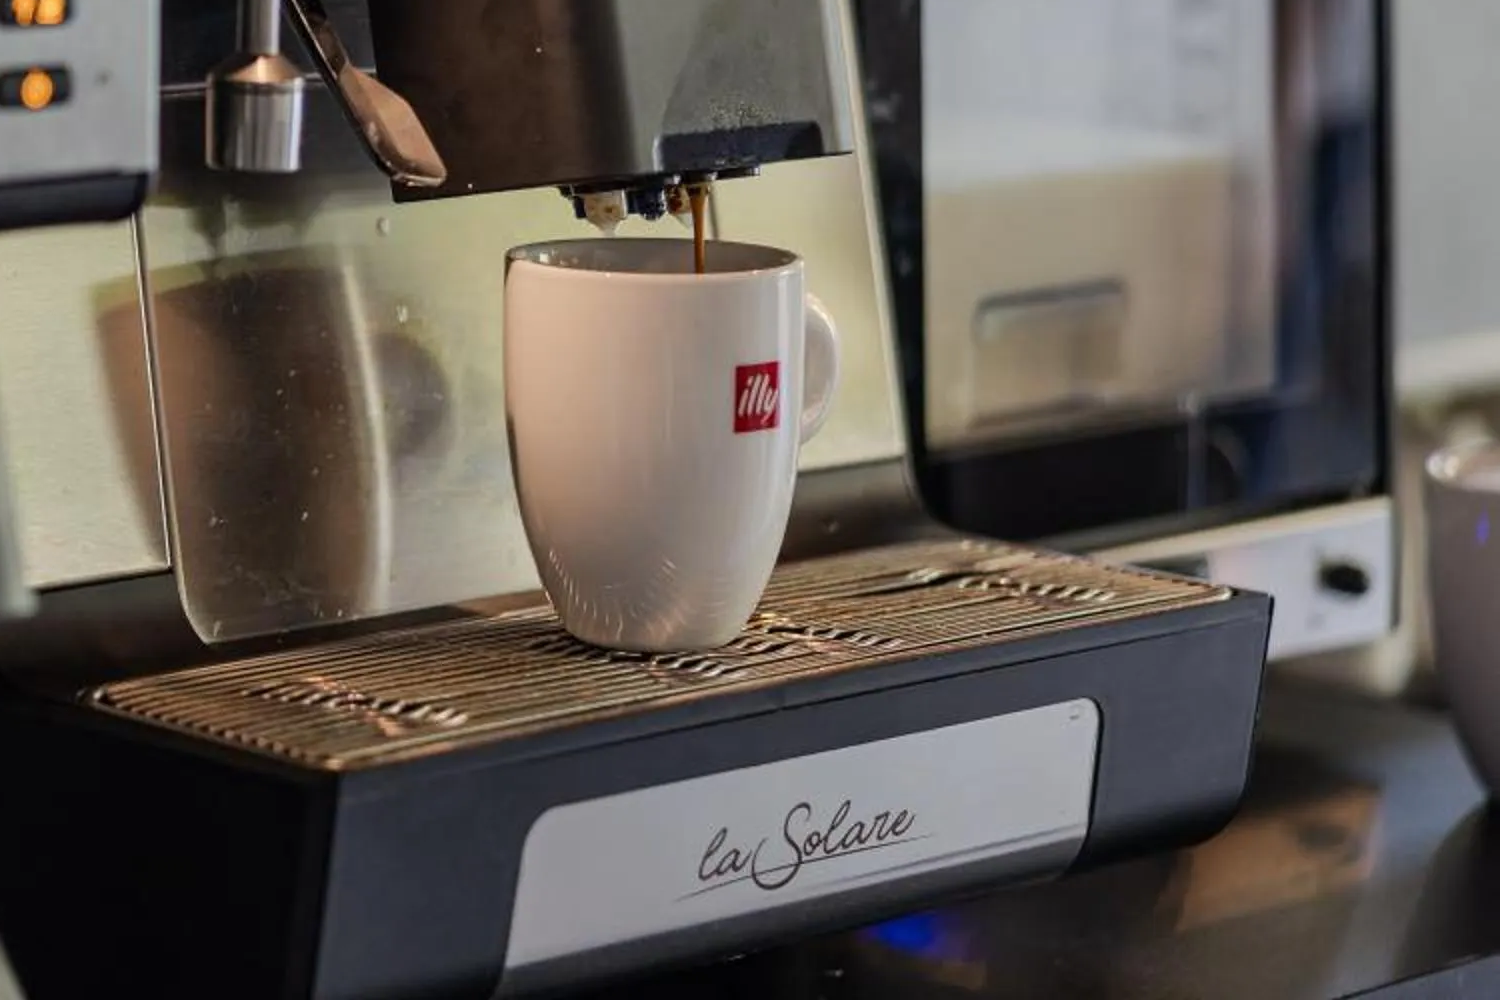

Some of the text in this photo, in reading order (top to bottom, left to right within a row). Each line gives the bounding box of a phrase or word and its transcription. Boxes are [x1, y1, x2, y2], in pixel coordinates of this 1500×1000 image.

[738, 371, 780, 426] illy
[698, 800, 917, 890] la Solare
